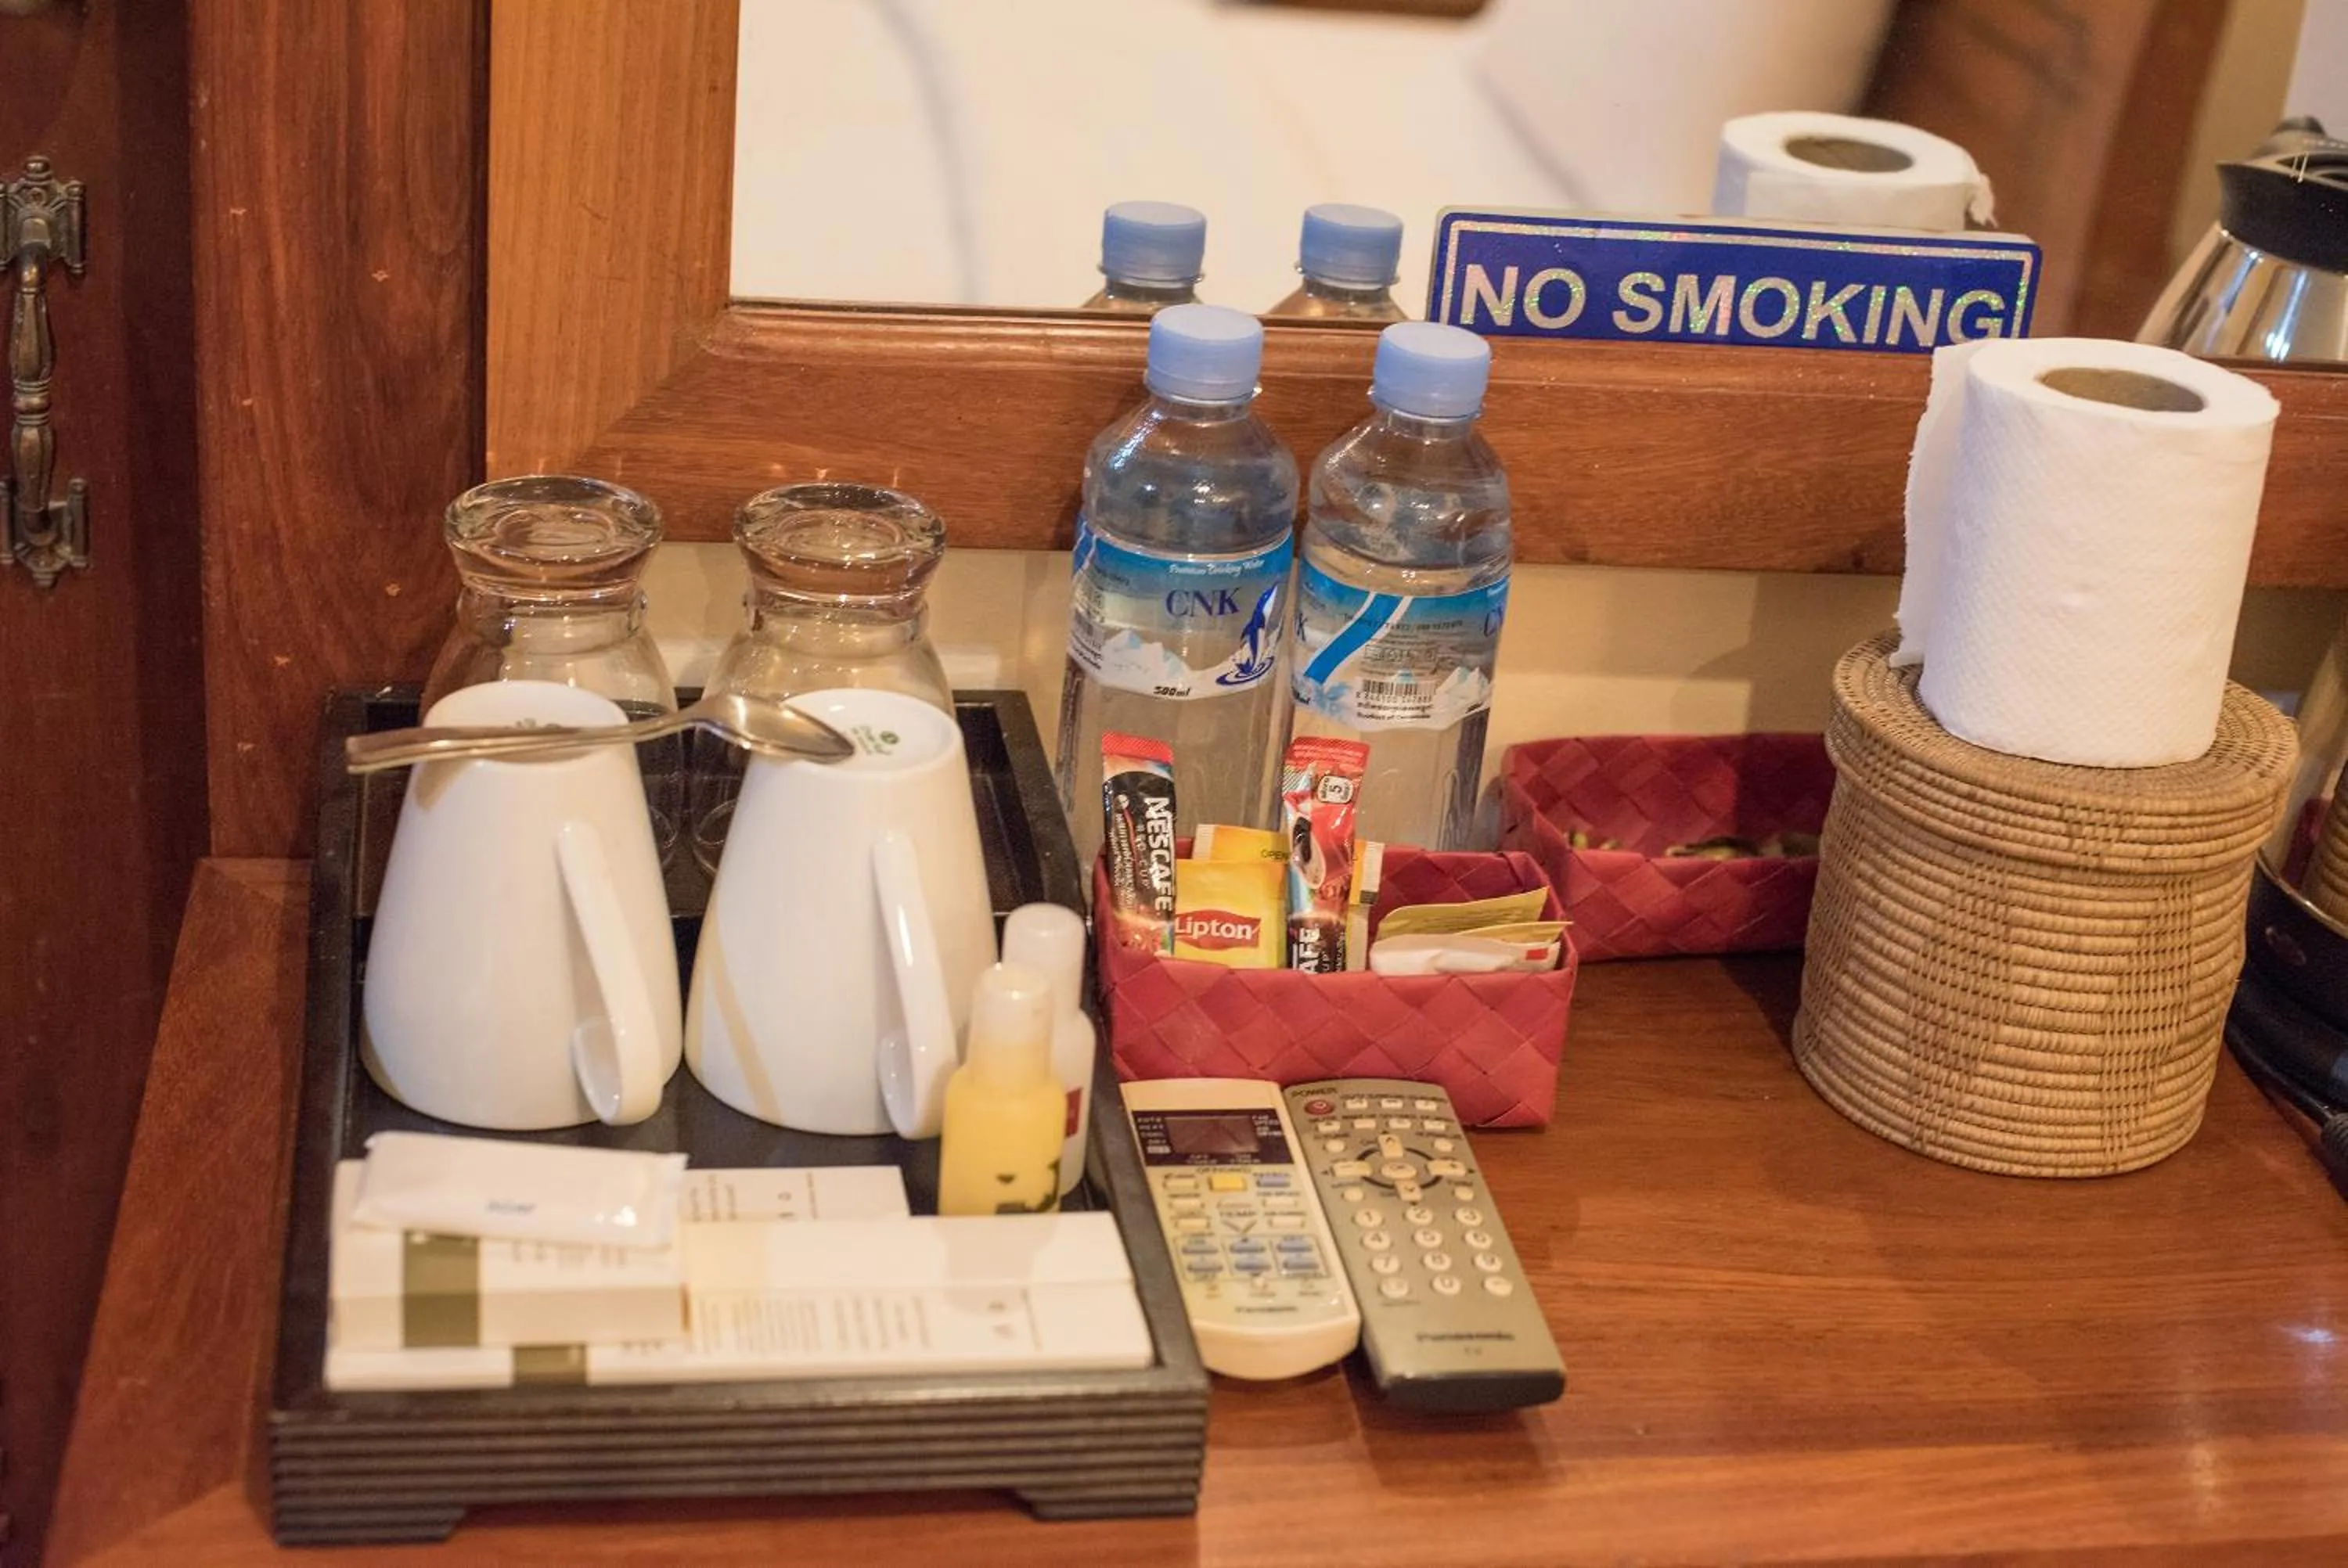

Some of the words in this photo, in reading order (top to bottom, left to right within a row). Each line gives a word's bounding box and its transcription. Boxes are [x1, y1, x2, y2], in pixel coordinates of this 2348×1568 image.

[1460, 264, 1586, 329] NO
[1612, 272, 2005, 347] SMOKING
[1165, 587, 1241, 617] CNK
[1153, 685, 1190, 696] 500ml
[1175, 916, 1252, 940] Lipton
